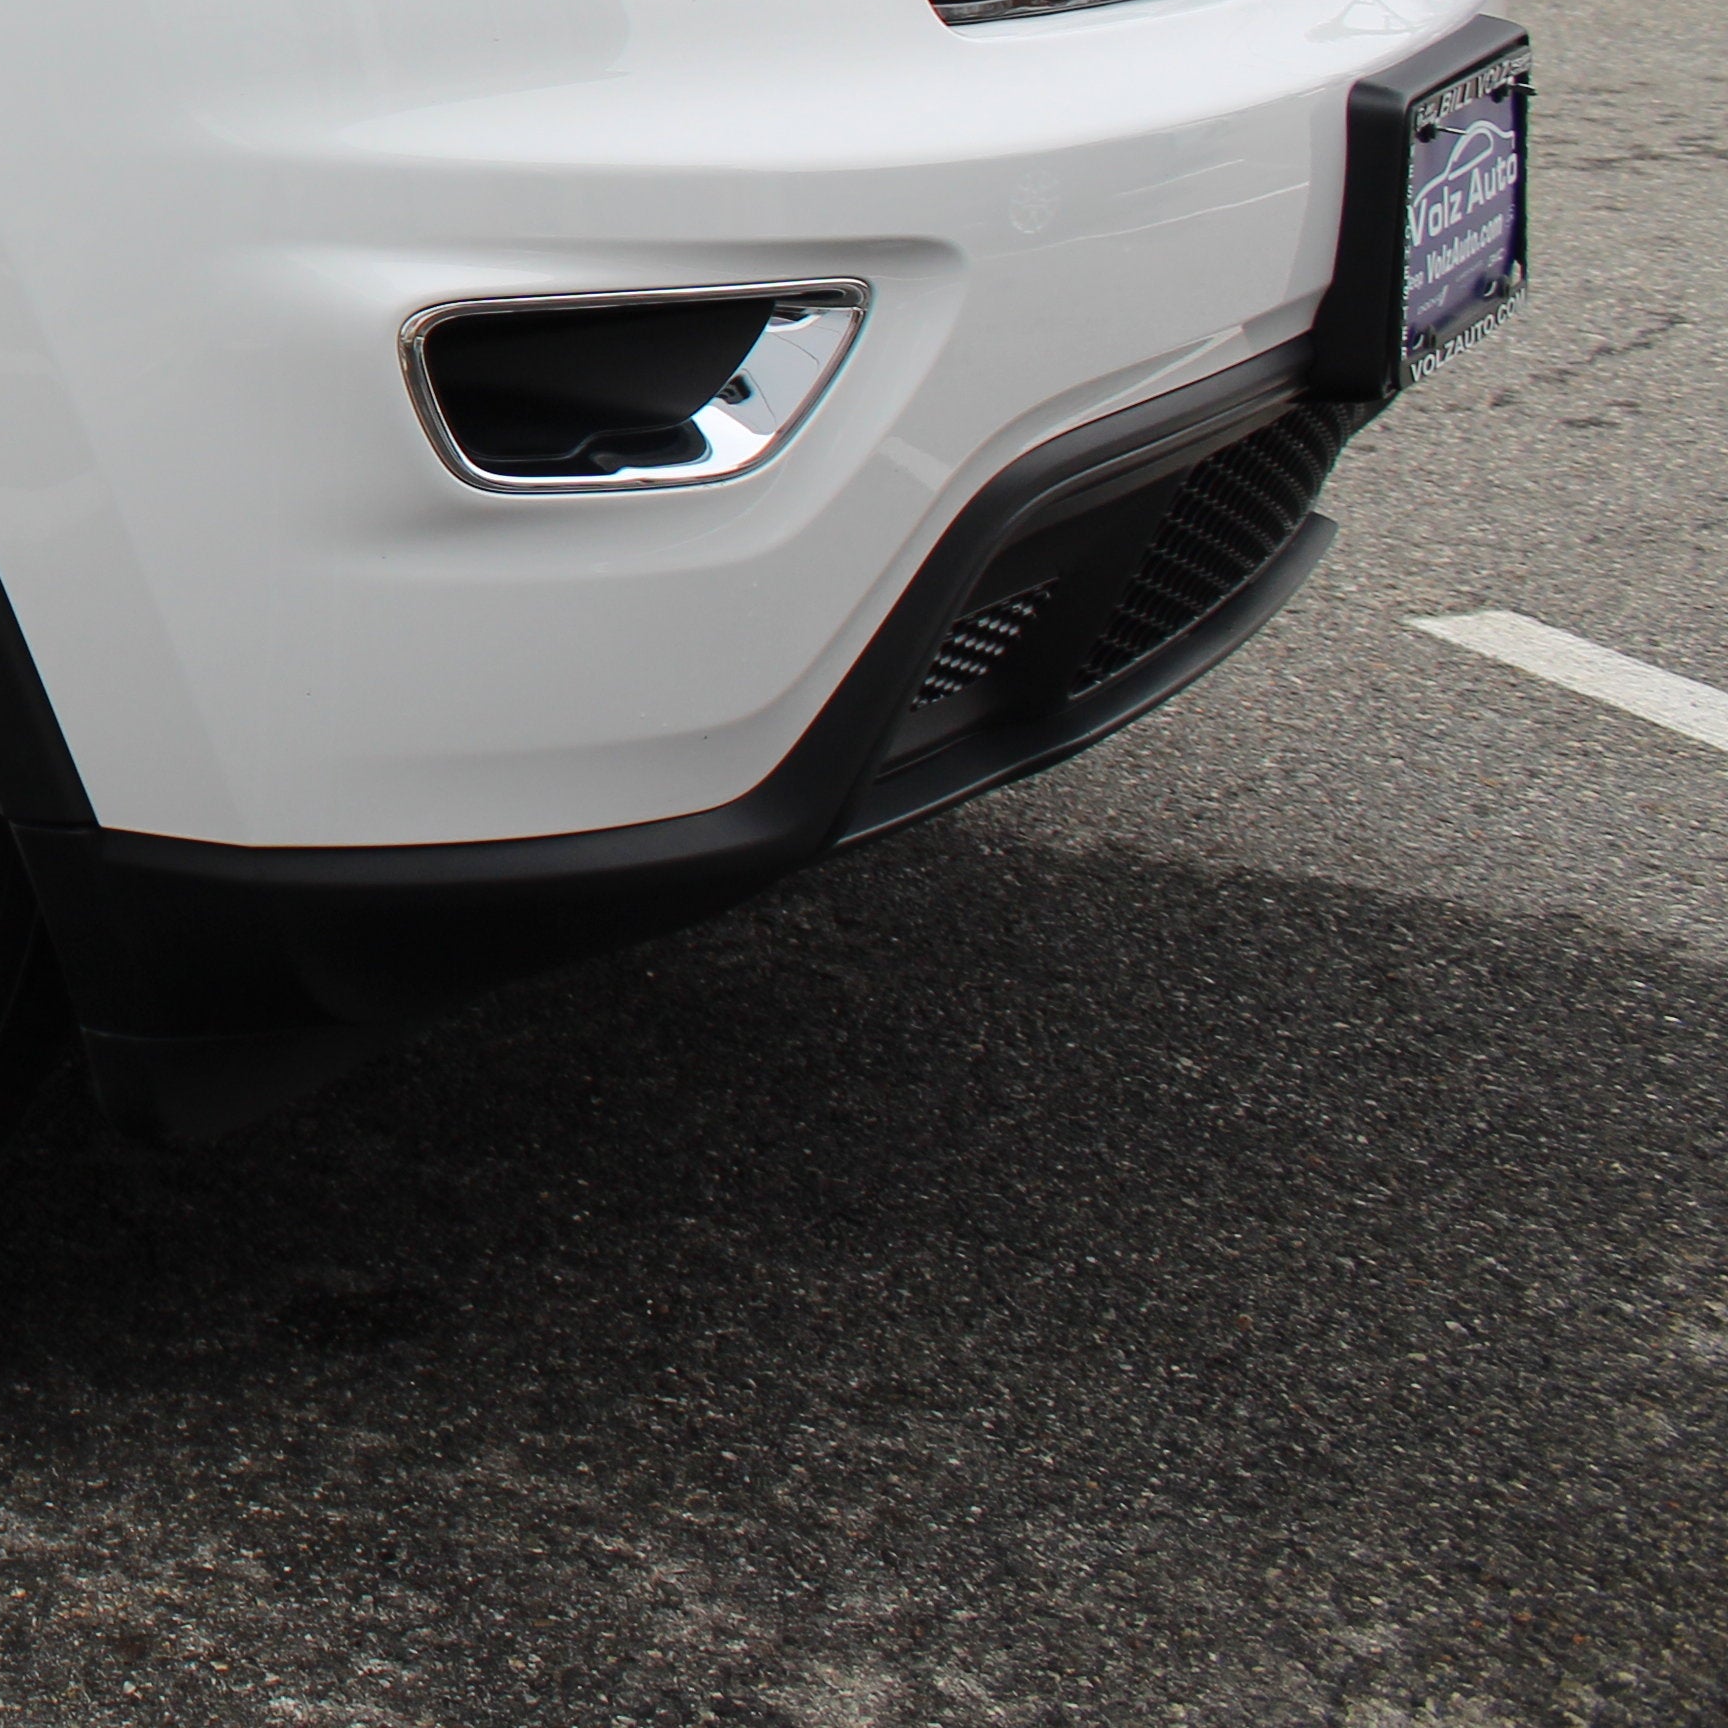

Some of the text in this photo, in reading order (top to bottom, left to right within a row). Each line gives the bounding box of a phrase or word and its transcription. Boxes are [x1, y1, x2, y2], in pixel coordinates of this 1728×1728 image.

[1440, 86, 1473, 118] BILL
[1407, 186, 1462, 246] Volz
[1466, 153, 1518, 214] Auto
[1426, 213, 1504, 284] VolzAuto.com
[1411, 288, 1526, 382] VOLZAUTO.COM
